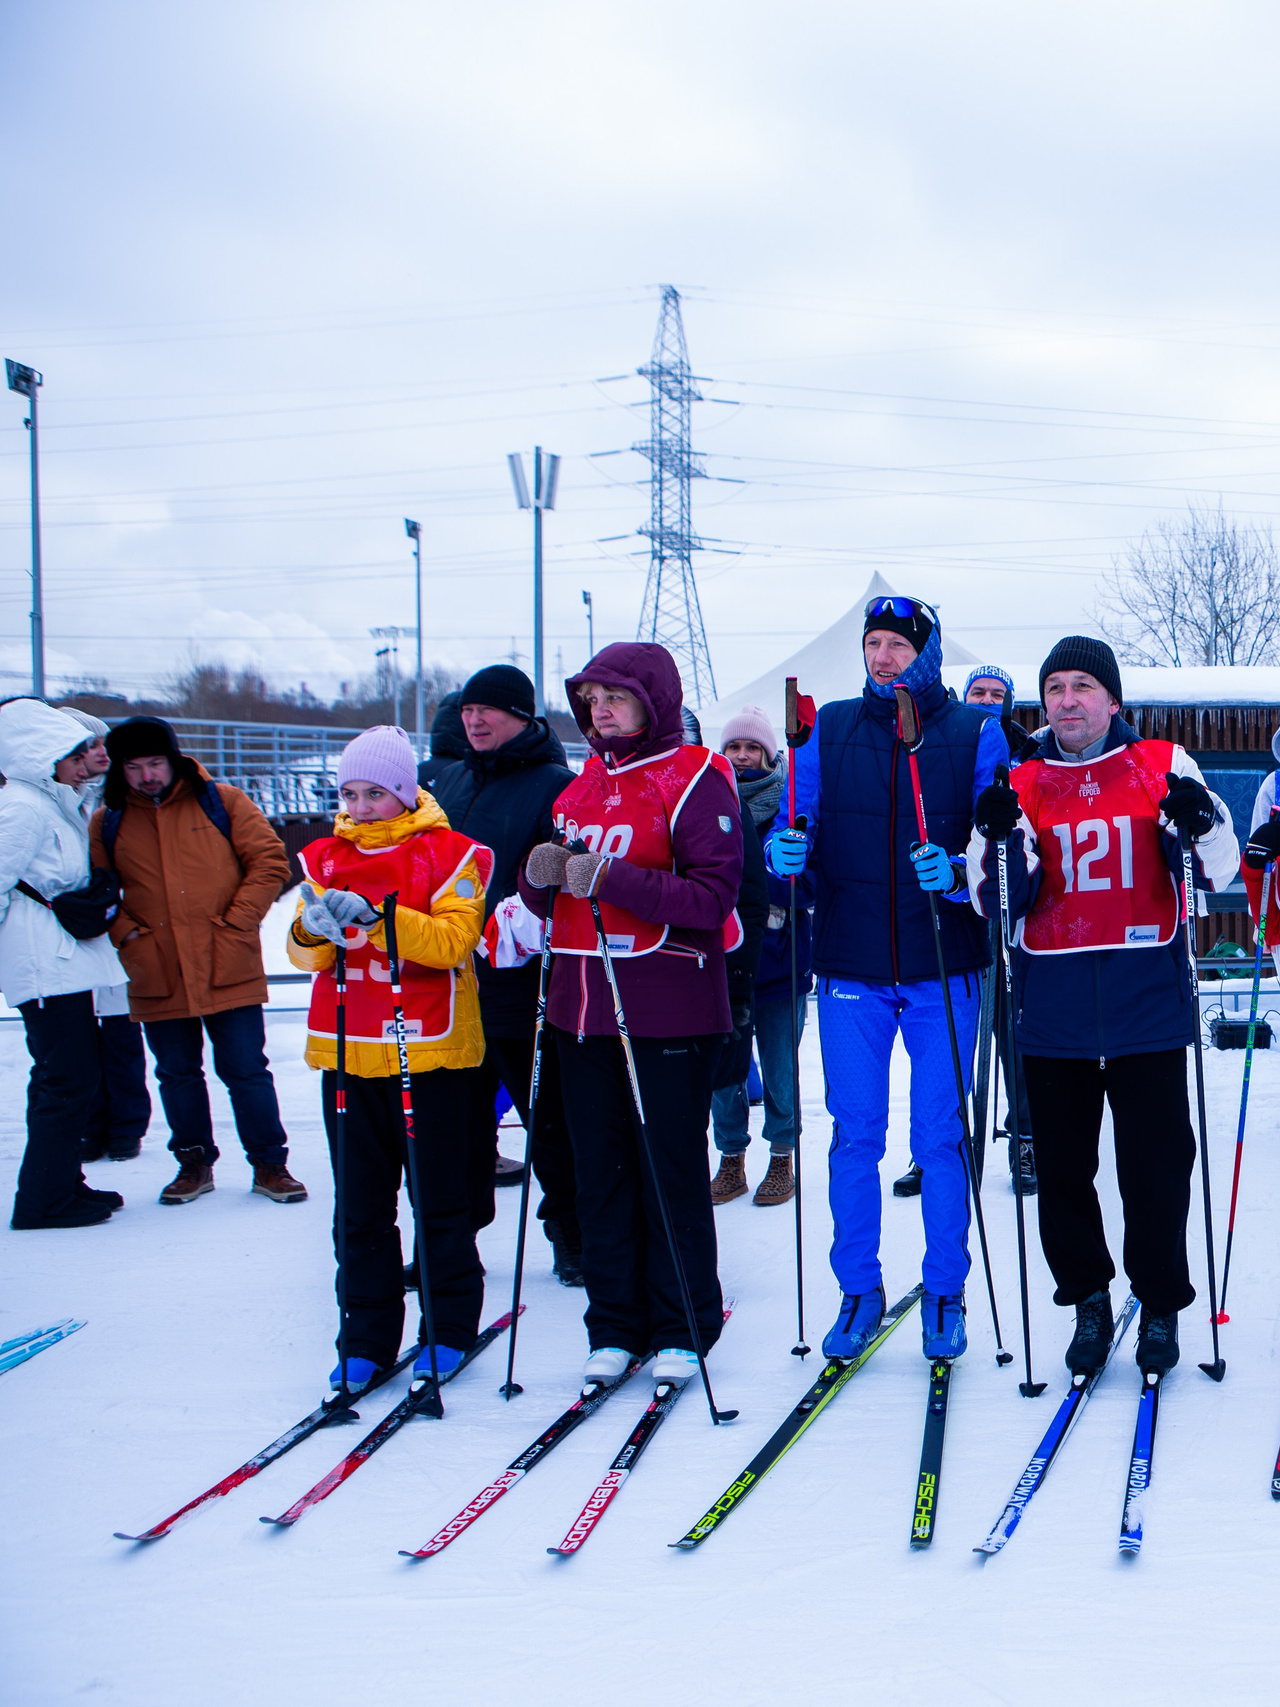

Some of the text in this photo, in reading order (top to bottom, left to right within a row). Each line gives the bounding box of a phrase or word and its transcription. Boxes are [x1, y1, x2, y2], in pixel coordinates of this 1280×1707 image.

[1078, 787, 1101, 798] ГЕРОЕВ
[1079, 782, 1099, 790] ЛЫЖНЯ
[1052, 815, 1134, 894] 121
[1185, 871, 1194, 914] NORDWAY
[395, 1010, 411, 1088] VUOKATTI
[404, 1115, 415, 1139] A7
[514, 1444, 544, 1469] ACTIVE
[615, 1445, 636, 1468] ACTIVE
[1008, 1457, 1047, 1509] NORDWAY
[421, 1471, 518, 1552] A3 BRADOS
[559, 1471, 622, 1551] A3 BRADOS
[686, 1470, 756, 1540] FISCHER
[912, 1471, 936, 1539] FISCHER
